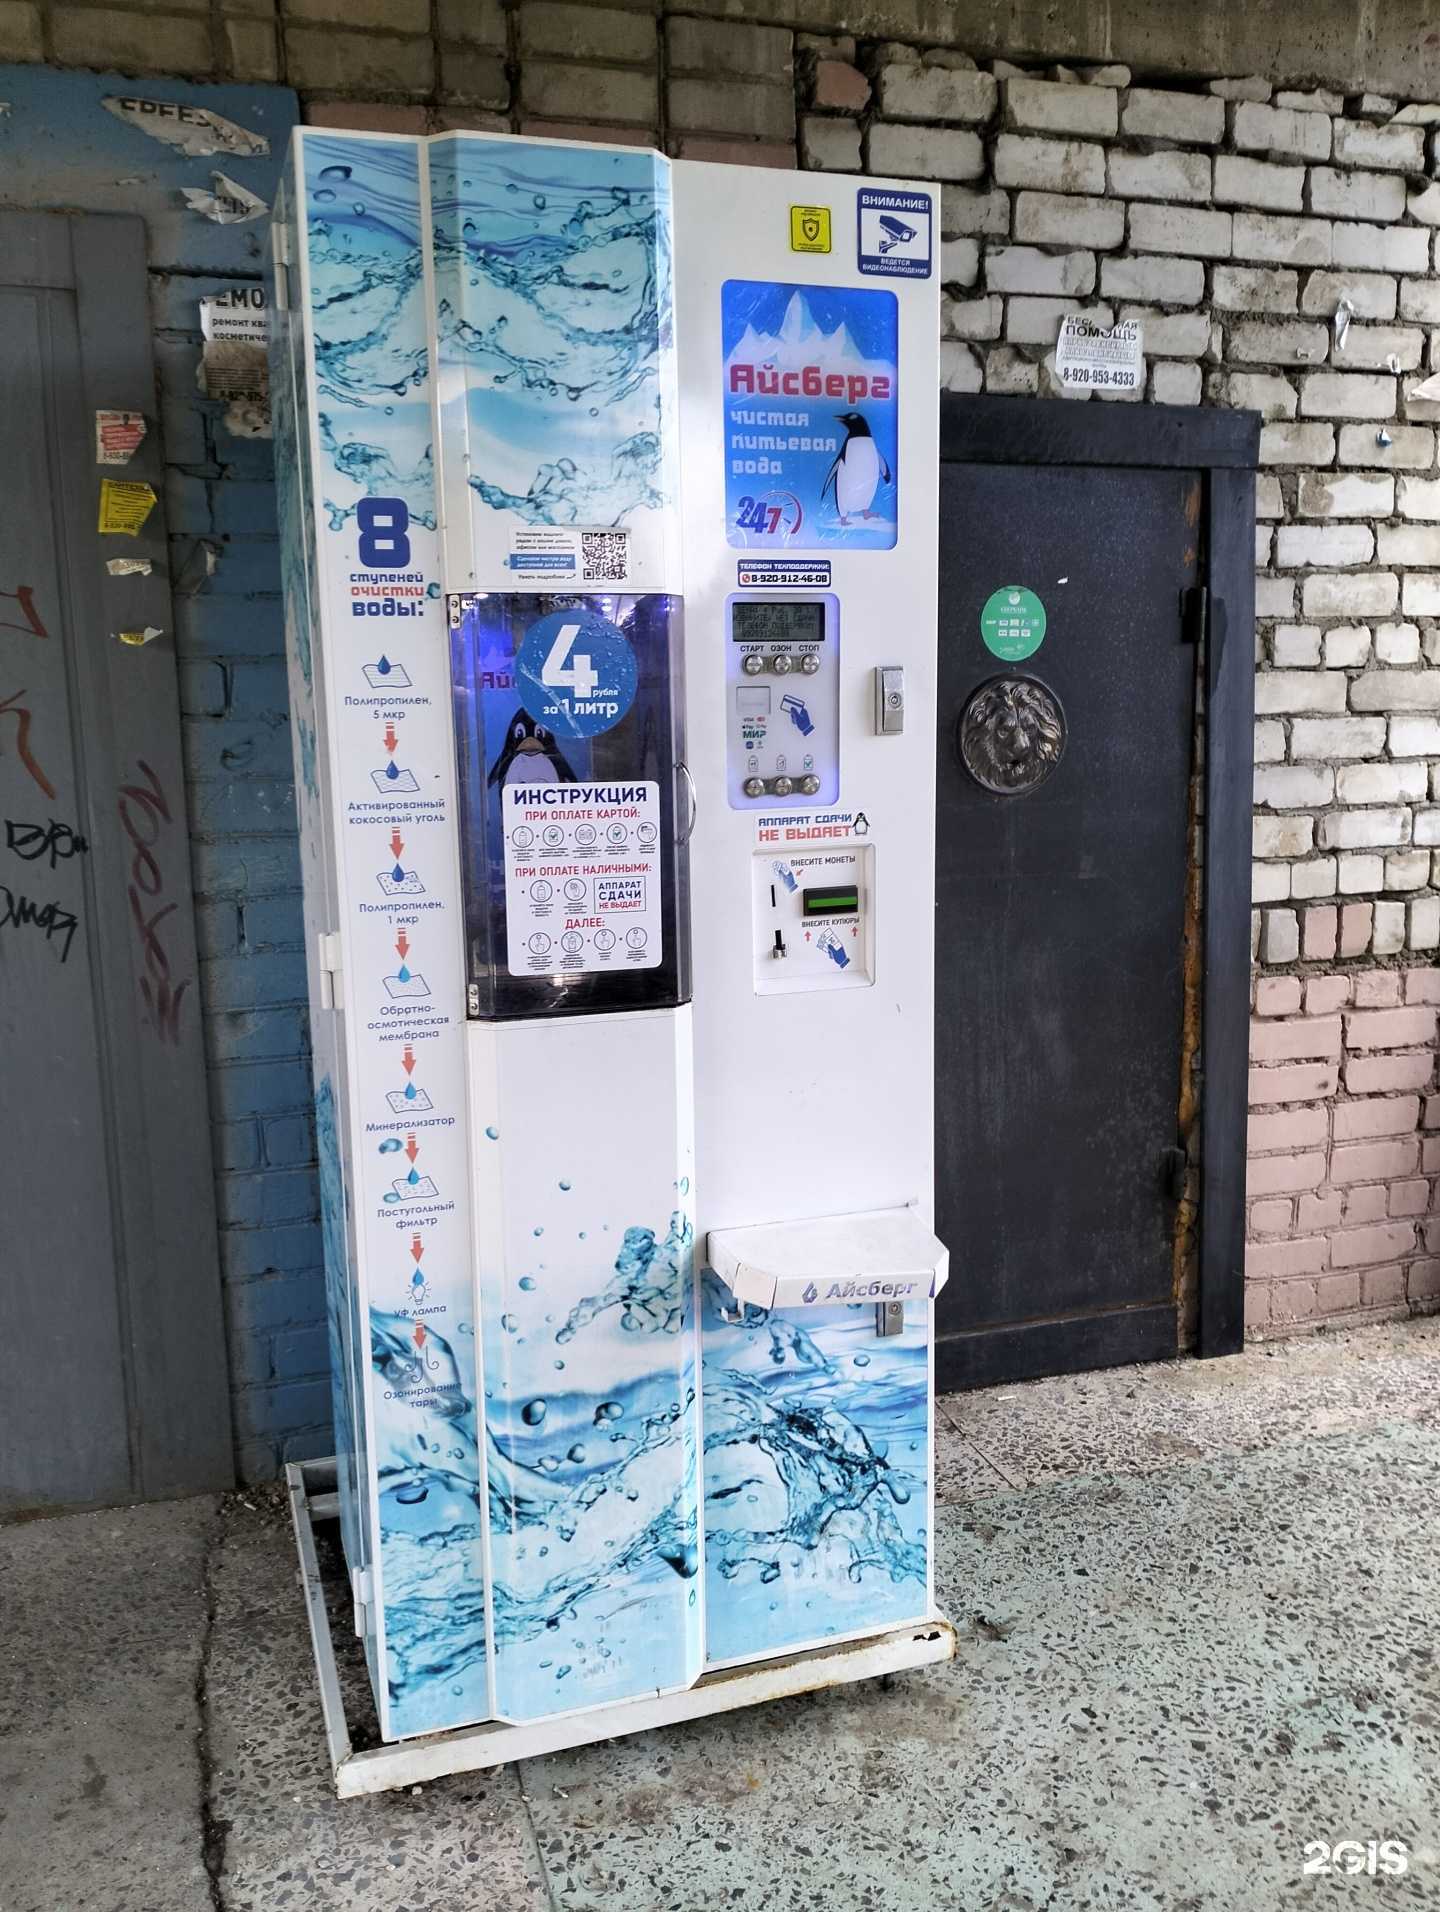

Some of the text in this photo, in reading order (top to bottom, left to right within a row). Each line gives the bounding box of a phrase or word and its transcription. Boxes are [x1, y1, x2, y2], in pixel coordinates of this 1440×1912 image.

[862, 195, 929, 210] ВНИМАНИЕ!
[862, 263, 929, 275] ВИДЕОНАБЛЮДЕНИЕ
[212, 318, 249, 328] ремонт
[1066, 325, 1137, 342] ПОМОЩЬ
[1063, 367, 1135, 386] 8-920-953-4333
[730, 364, 890, 405] Айсберг
[731, 410, 810, 426] чистая
[732, 433, 837, 451] питьевая
[732, 457, 783, 474] вода
[357, 497, 411, 568] 8
[350, 572, 423, 584] ступеней
[751, 574, 827, 583] 8-920-912-46-08
[351, 586, 424, 597] очистки
[352, 598, 424, 617] воды:
[798, 644, 820, 652] СТОП
[541, 624, 598, 698] 4
[592, 690, 618, 699] рубля
[345, 696, 432, 707] Полипропилен,
[543, 698, 619, 718] за 1 литр
[373, 710, 406, 721] 5 мкр
[743, 730, 767, 739] МИР
[514, 787, 647, 806] ИНСТРУКЦИЯ
[348, 798, 446, 812] Активированный
[349, 813, 446, 825] кокосовый уголь
[525, 806, 641, 821] ПРИ ОПЛАТЕ КАРТОЙ:
[758, 813, 852, 827] АППАРАТ СДАЧИ
[759, 825, 853, 842] НЕ ВЫДАЕТ
[790, 855, 856, 867] ВНЕСИТЕ МОНЕТЫ
[515, 863, 652, 877] ПРИ ОПЛАТЕ НАЛИЧНЫМИ:
[598, 881, 642, 890] АППАРАТ
[598, 890, 642, 901] СДАЧИ
[359, 901, 445, 914] Полипропилен,
[610, 900, 642, 909] ВЫДАЕТ
[388, 915, 419, 925] 1 мкр
[565, 917, 605, 930] ДАЛЕЕ:
[801, 919, 830, 928] ВНЕСИТЕ
[379, 1004, 436, 1017] Обратно-
[367, 1016, 450, 1030] осмотическая
[378, 1029, 440, 1042] мембрана
[366, 1116, 455, 1132] Минерализатор
[377, 1201, 455, 1218] Постугольный
[396, 1216, 438, 1230] фильтр
[826, 1280, 918, 1299] Айсберг
[411, 1304, 447, 1317] лампа
[402, 1398, 438, 1409] тары
